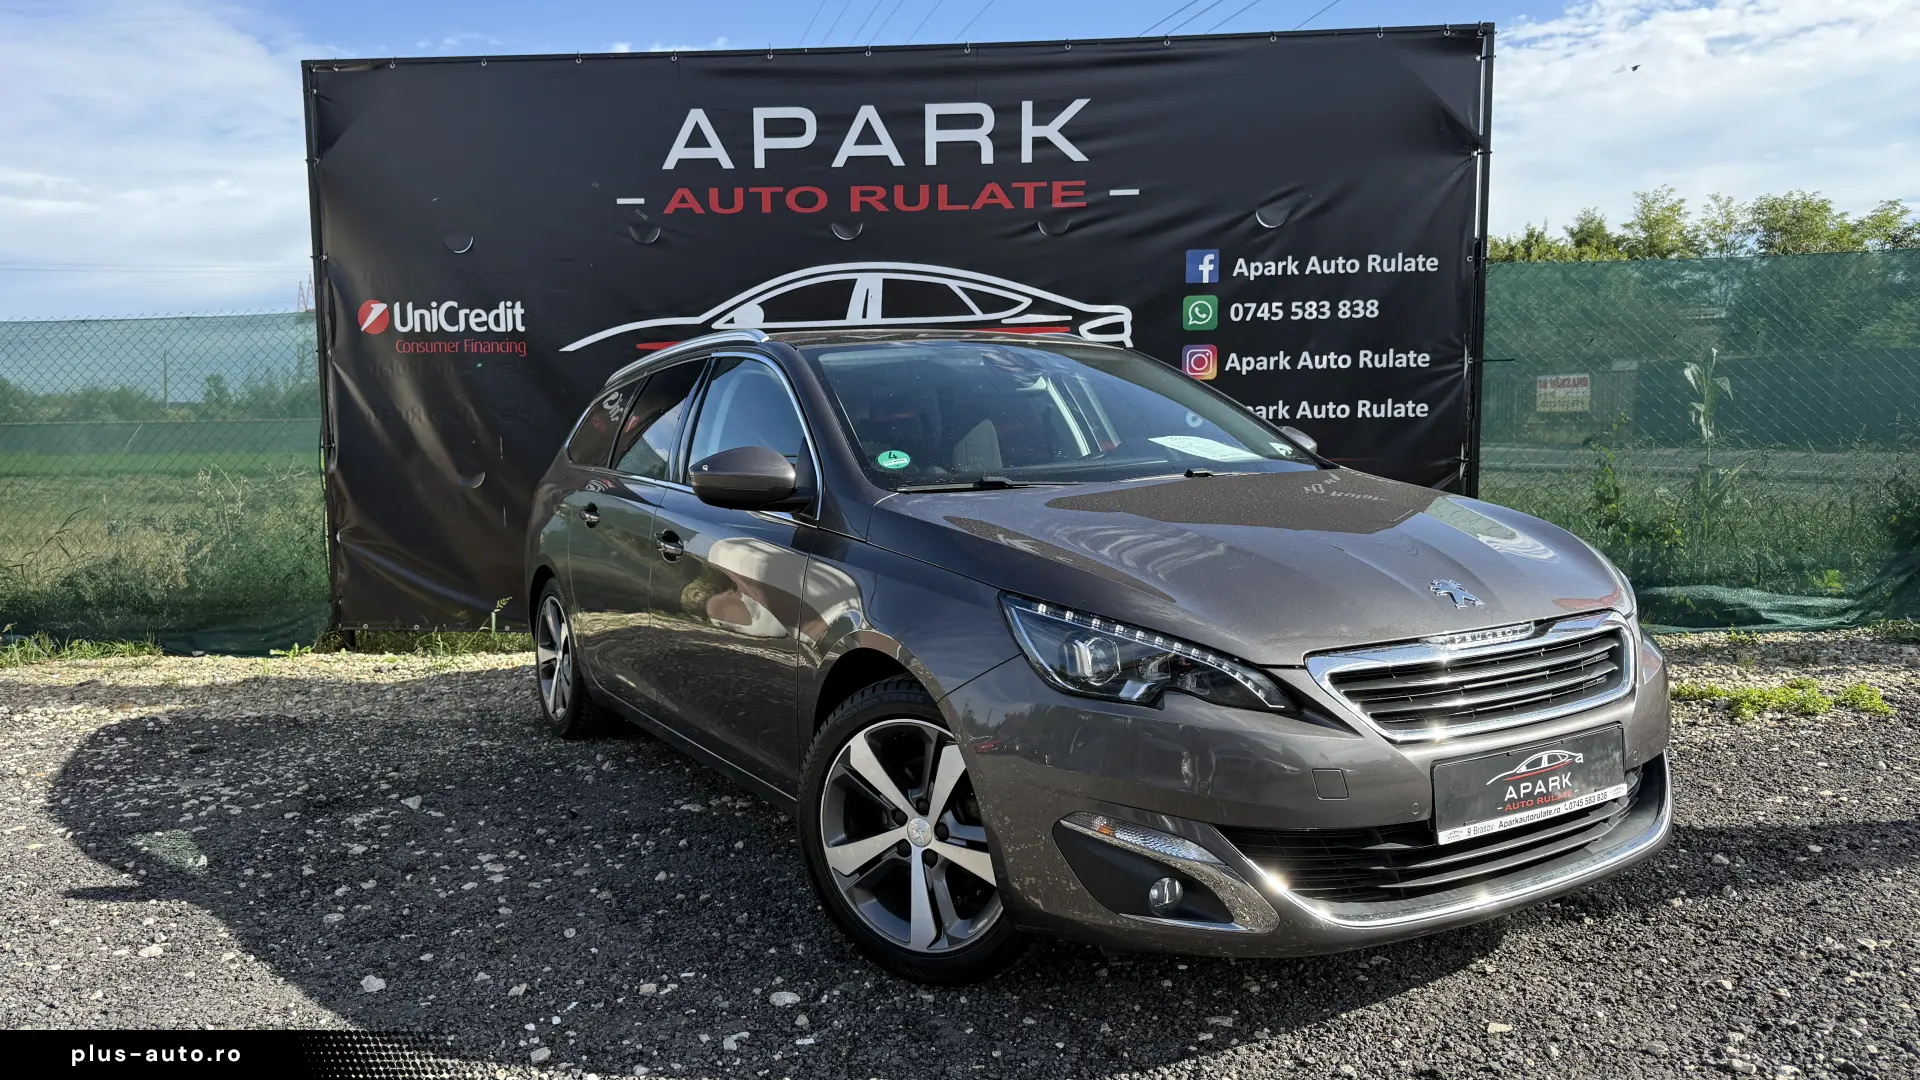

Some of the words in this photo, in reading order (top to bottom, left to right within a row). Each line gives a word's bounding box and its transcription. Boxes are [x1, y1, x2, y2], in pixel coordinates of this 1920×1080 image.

[663, 98, 1091, 170] APARK
[663, 186, 829, 214] AUTO
[850, 180, 1088, 213] RULATE
[1232, 255, 1300, 281] Apark
[1304, 255, 1360, 275] Auto
[1367, 252, 1439, 273] Rulate
[393, 300, 525, 332] UniCredit
[1229, 302, 1284, 322] 0745
[1290, 300, 1331, 321] 583
[1337, 299, 1379, 319] 838
[395, 339, 460, 353] Consumer
[464, 338, 527, 357] Financing
[1224, 350, 1292, 376] Apark
[1296, 351, 1352, 370] Auto
[1358, 348, 1431, 369] Rulate
[1295, 400, 1351, 419] Auto
[1357, 398, 1429, 419] Rulate
[1505, 772, 1572, 801] APARK
[1505, 799, 1534, 812] AUTO
[1537, 790, 1573, 804] RULATE
[1498, 807, 1561, 829] Aparkautorulate.ro
[1569, 800, 1583, 810] 0745
[1585, 796, 1595, 805] 583
